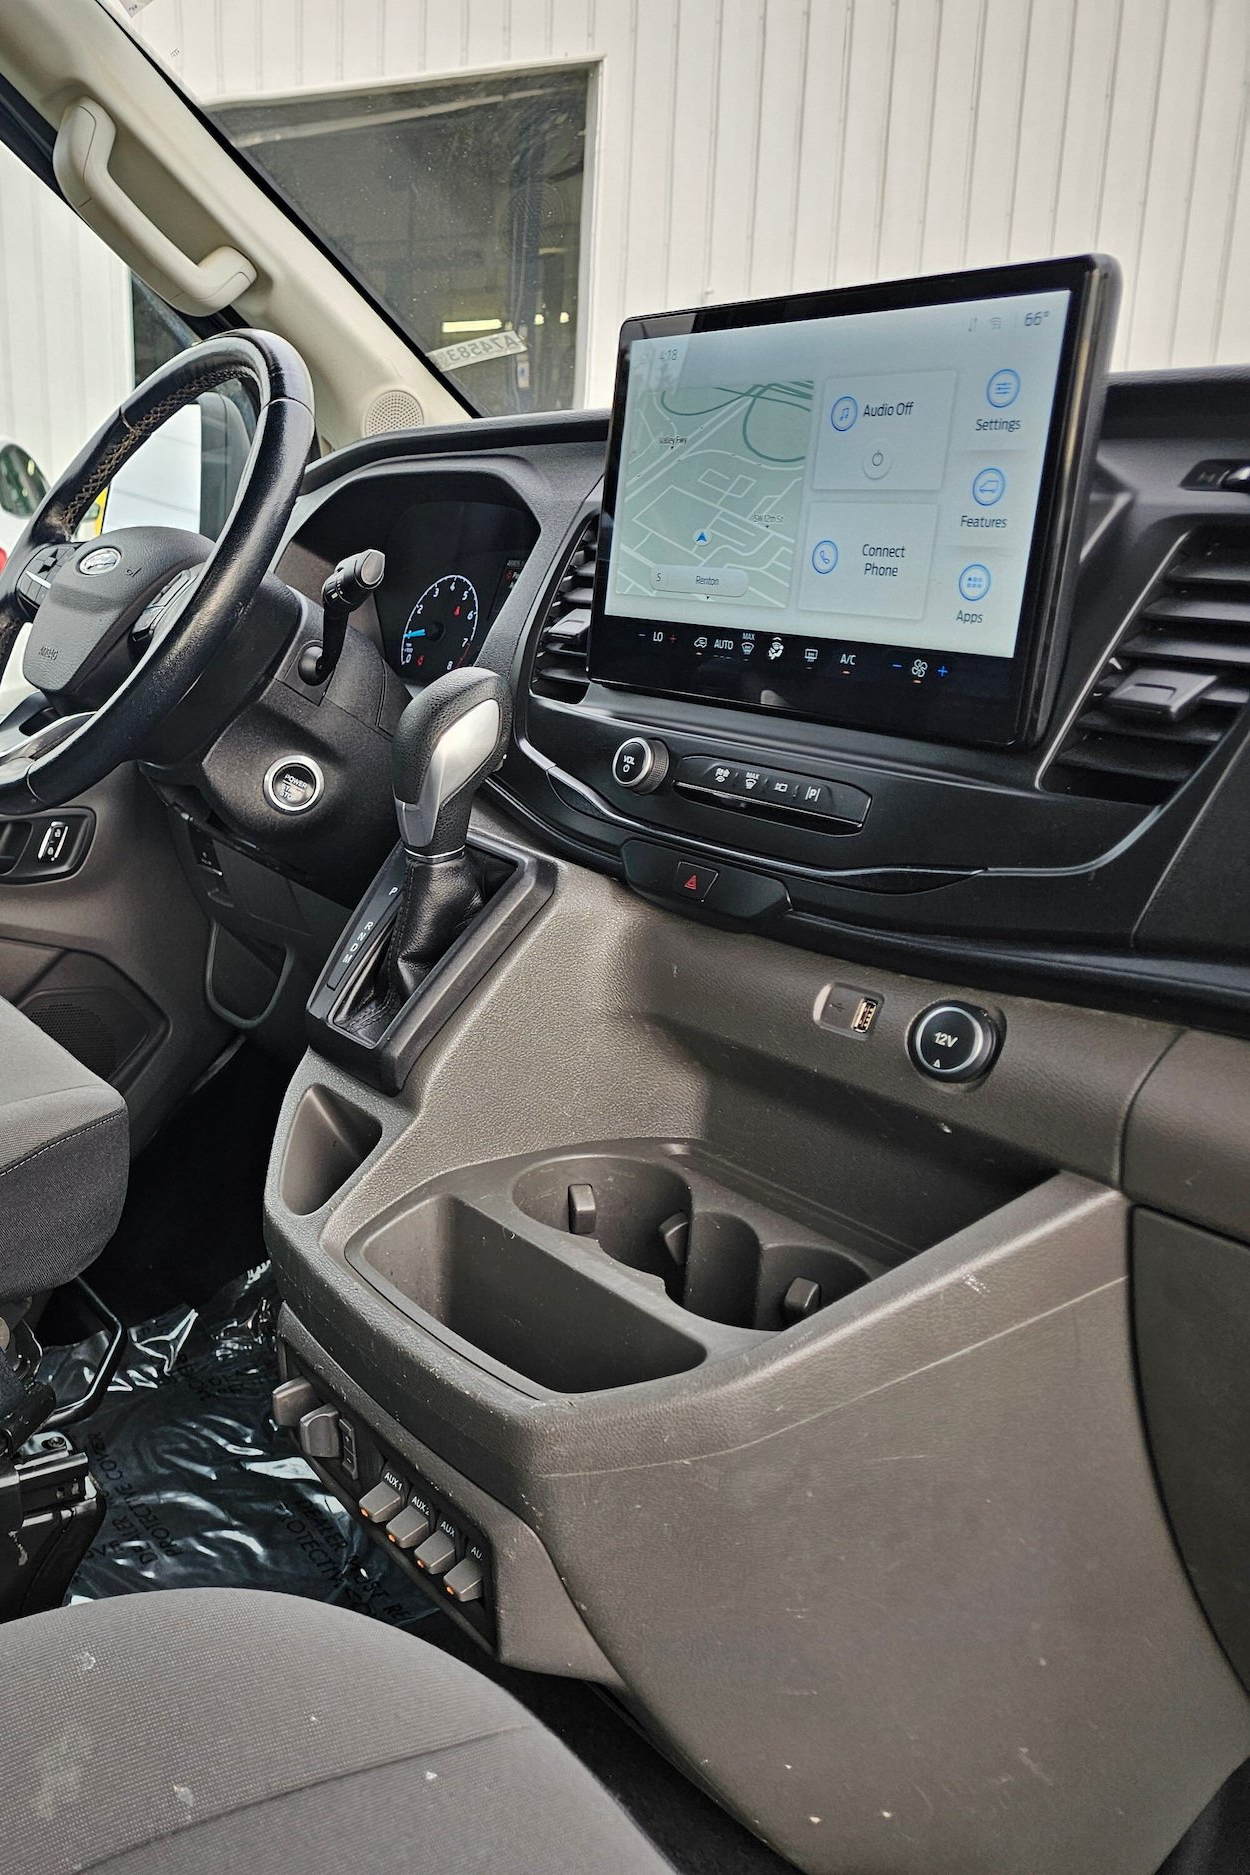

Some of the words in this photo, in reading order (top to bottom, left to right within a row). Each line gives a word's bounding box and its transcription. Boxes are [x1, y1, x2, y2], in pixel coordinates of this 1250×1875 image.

[863, 404, 894, 417] Audio
[896, 402, 914, 416] Off
[975, 418, 1021, 432] Settings
[960, 515, 1007, 529] Features
[862, 544, 906, 558] Connect
[864, 563, 899, 577] Phone
[695, 576, 719, 586] Renton
[432, 588, 440, 598] 3
[416, 605, 424, 615] 2
[466, 610, 474, 621] 6
[955, 610, 983, 625] Apps
[461, 637, 469, 648] 7
[742, 633, 756, 641] MAX
[714, 640, 734, 650] AUTO
[405, 653, 412, 664] 0
[840, 654, 857, 666] A/C
[446, 660, 454, 671] 8
[623, 754, 635, 766] VOL
[285, 773, 308, 789] POWER
[745, 771, 760, 780] MAX
[389, 886, 399, 896] P
[364, 921, 374, 931] R
[357, 932, 366, 942] N
[350, 943, 359, 952] D
[933, 1031, 958, 1048] 12V
[384, 1471, 399, 1488] AUX
[411, 1495, 426, 1512] AUX
[440, 1520, 456, 1537] AUX
[470, 1546, 483, 1560] AU
